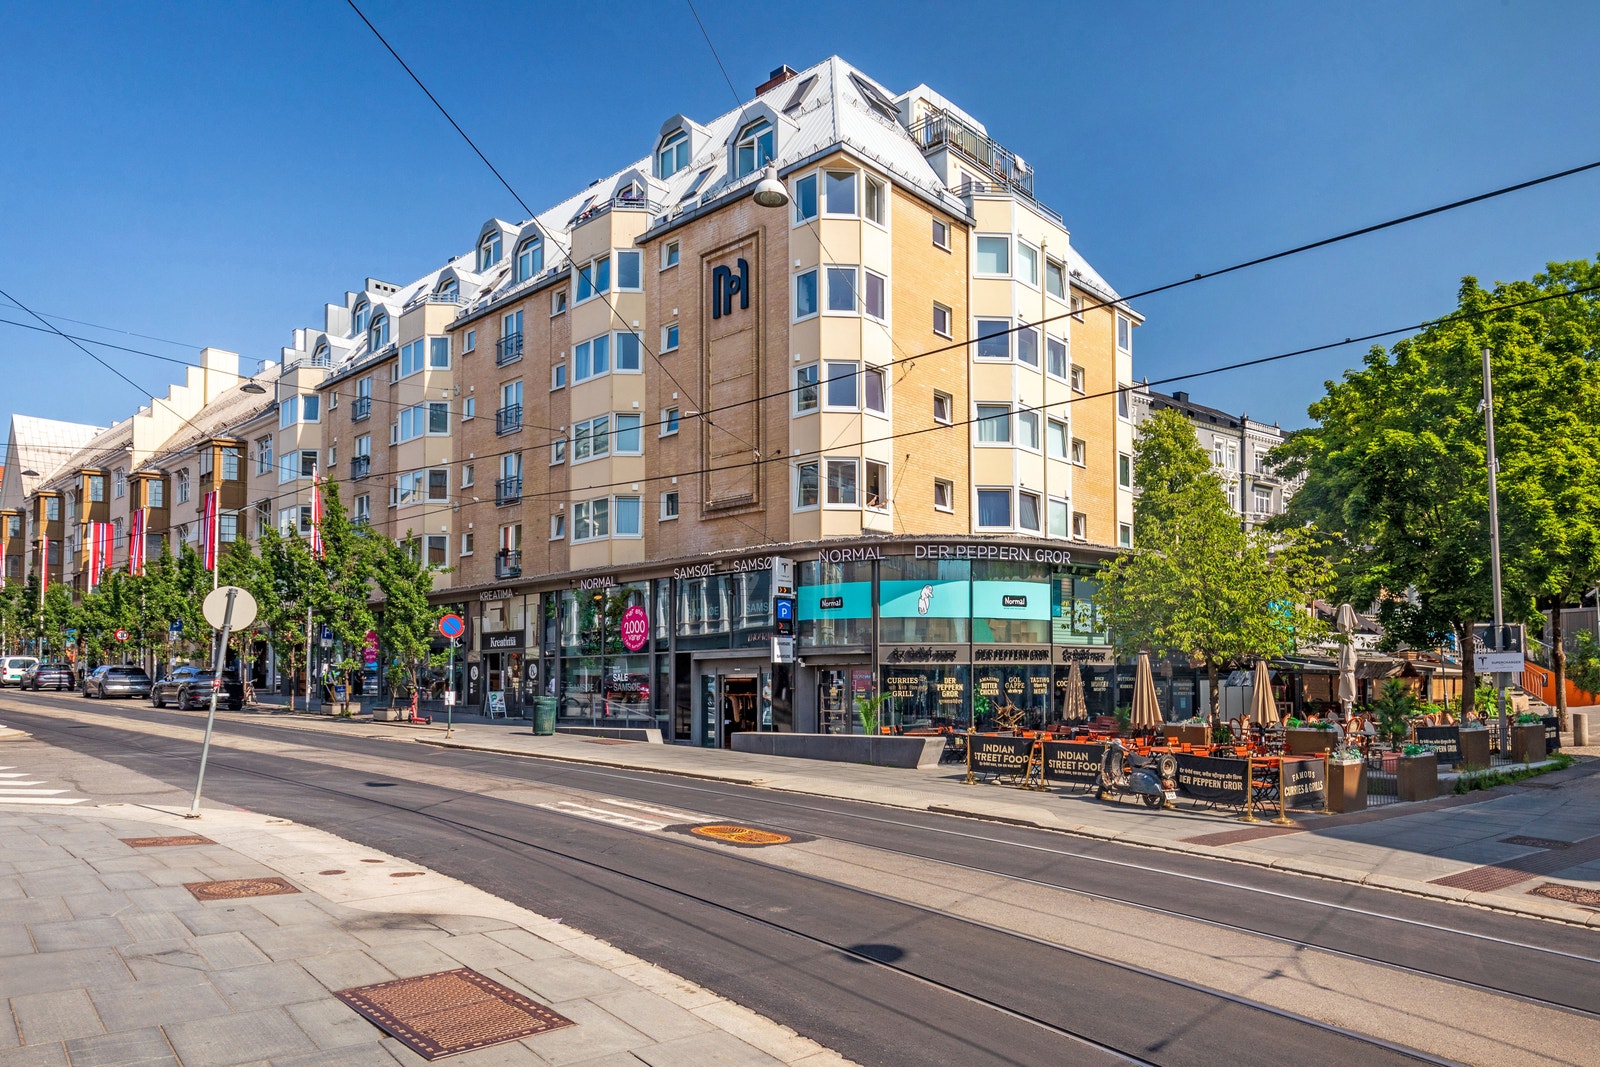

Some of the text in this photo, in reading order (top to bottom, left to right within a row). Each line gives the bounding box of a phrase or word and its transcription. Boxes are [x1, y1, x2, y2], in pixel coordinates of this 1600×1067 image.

[818, 546, 886, 563] NORMAL
[915, 545, 1072, 564] DER PEPPERN GROR
[673, 556, 773, 580] SAMSØE SAMSØ
[579, 576, 616, 590] NORMAL
[479, 588, 514, 602] KREATIMA
[1004, 596, 1026, 606] Normal
[822, 599, 842, 608] Normal
[624, 619, 646, 635] 2000
[118, 631, 128, 639] 30
[489, 635, 517, 649] Kreatima
[612, 672, 629, 682] SALE
[983, 743, 1015, 754] INDIAN
[974, 752, 1029, 764] STREET FOOD
[1057, 750, 1089, 761] INDIAN
[1048, 759, 1076, 770] STREET
[1291, 770, 1316, 783] FAMOUS
[1192, 777, 1222, 789] PEPPERN
[1222, 780, 1243, 791] GROR
[1284, 784, 1304, 797] CURRIES
